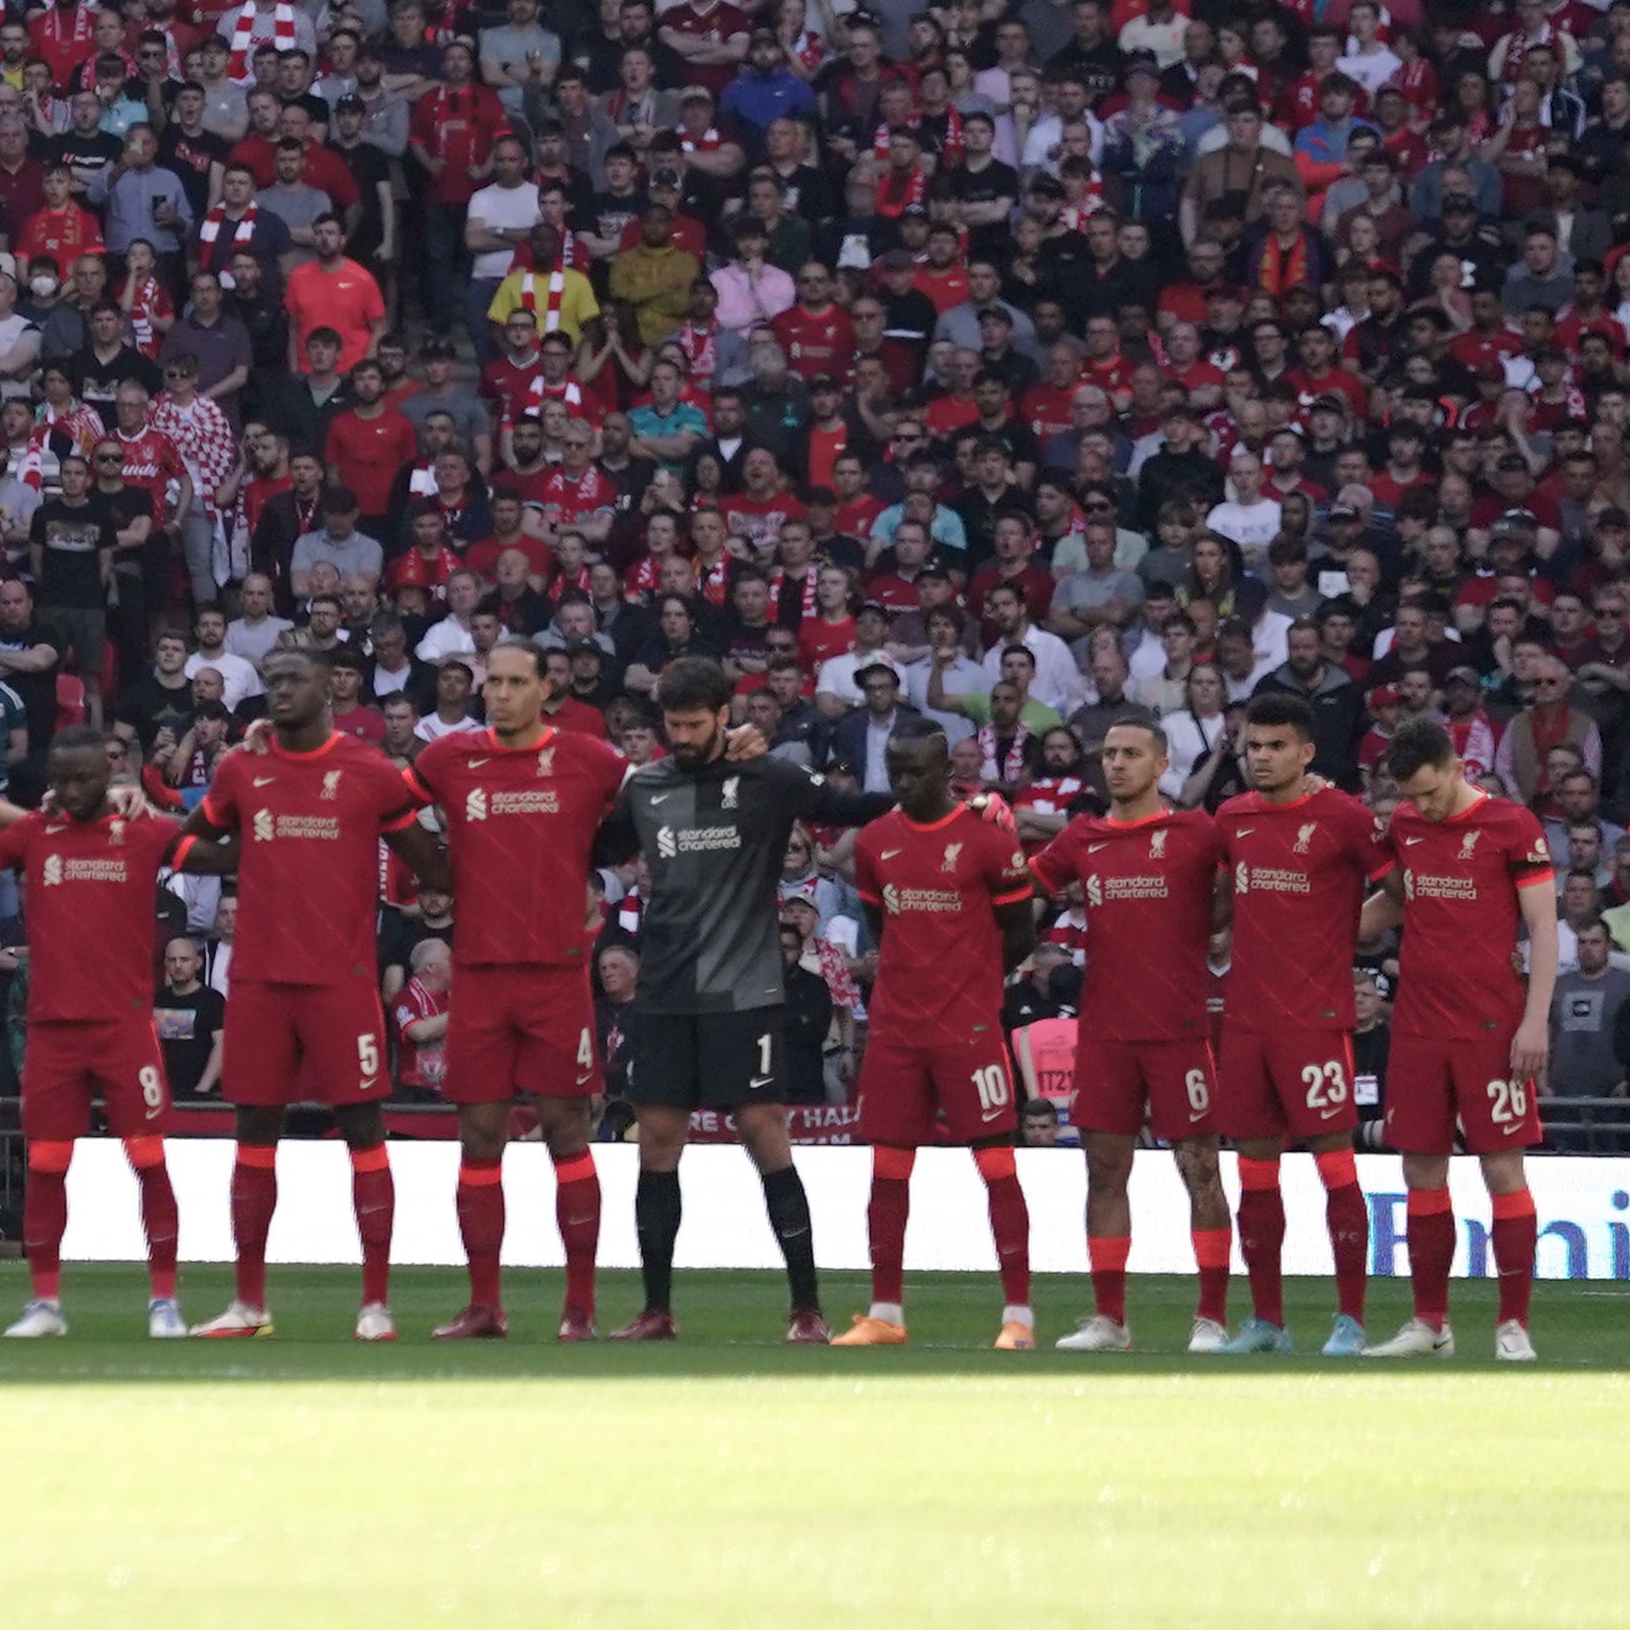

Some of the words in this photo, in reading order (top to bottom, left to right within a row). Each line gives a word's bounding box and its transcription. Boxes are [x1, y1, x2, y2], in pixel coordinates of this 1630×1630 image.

[491, 791, 555, 805] standard
[491, 801, 560, 816] chartered
[677, 827, 737, 841] standard
[677, 837, 742, 852] chartered
[1105, 876, 1164, 889] standard
[1251, 869, 1307, 883] standard
[1417, 876, 1474, 889] standard
[1104, 887, 1168, 900] chartered
[1251, 880, 1310, 893] chartered
[1416, 885, 1477, 901] chartered
[901, 888, 959, 901] standard
[901, 899, 962, 912] chartered
[357, 1032, 378, 1076] 5
[756, 1034, 772, 1074] 1
[139, 1065, 163, 1107] 8
[970, 1064, 1009, 1110] 10
[1185, 1068, 1209, 1110] 6
[1301, 1061, 1346, 1110] 23
[1486, 1079, 1527, 1122] 26
